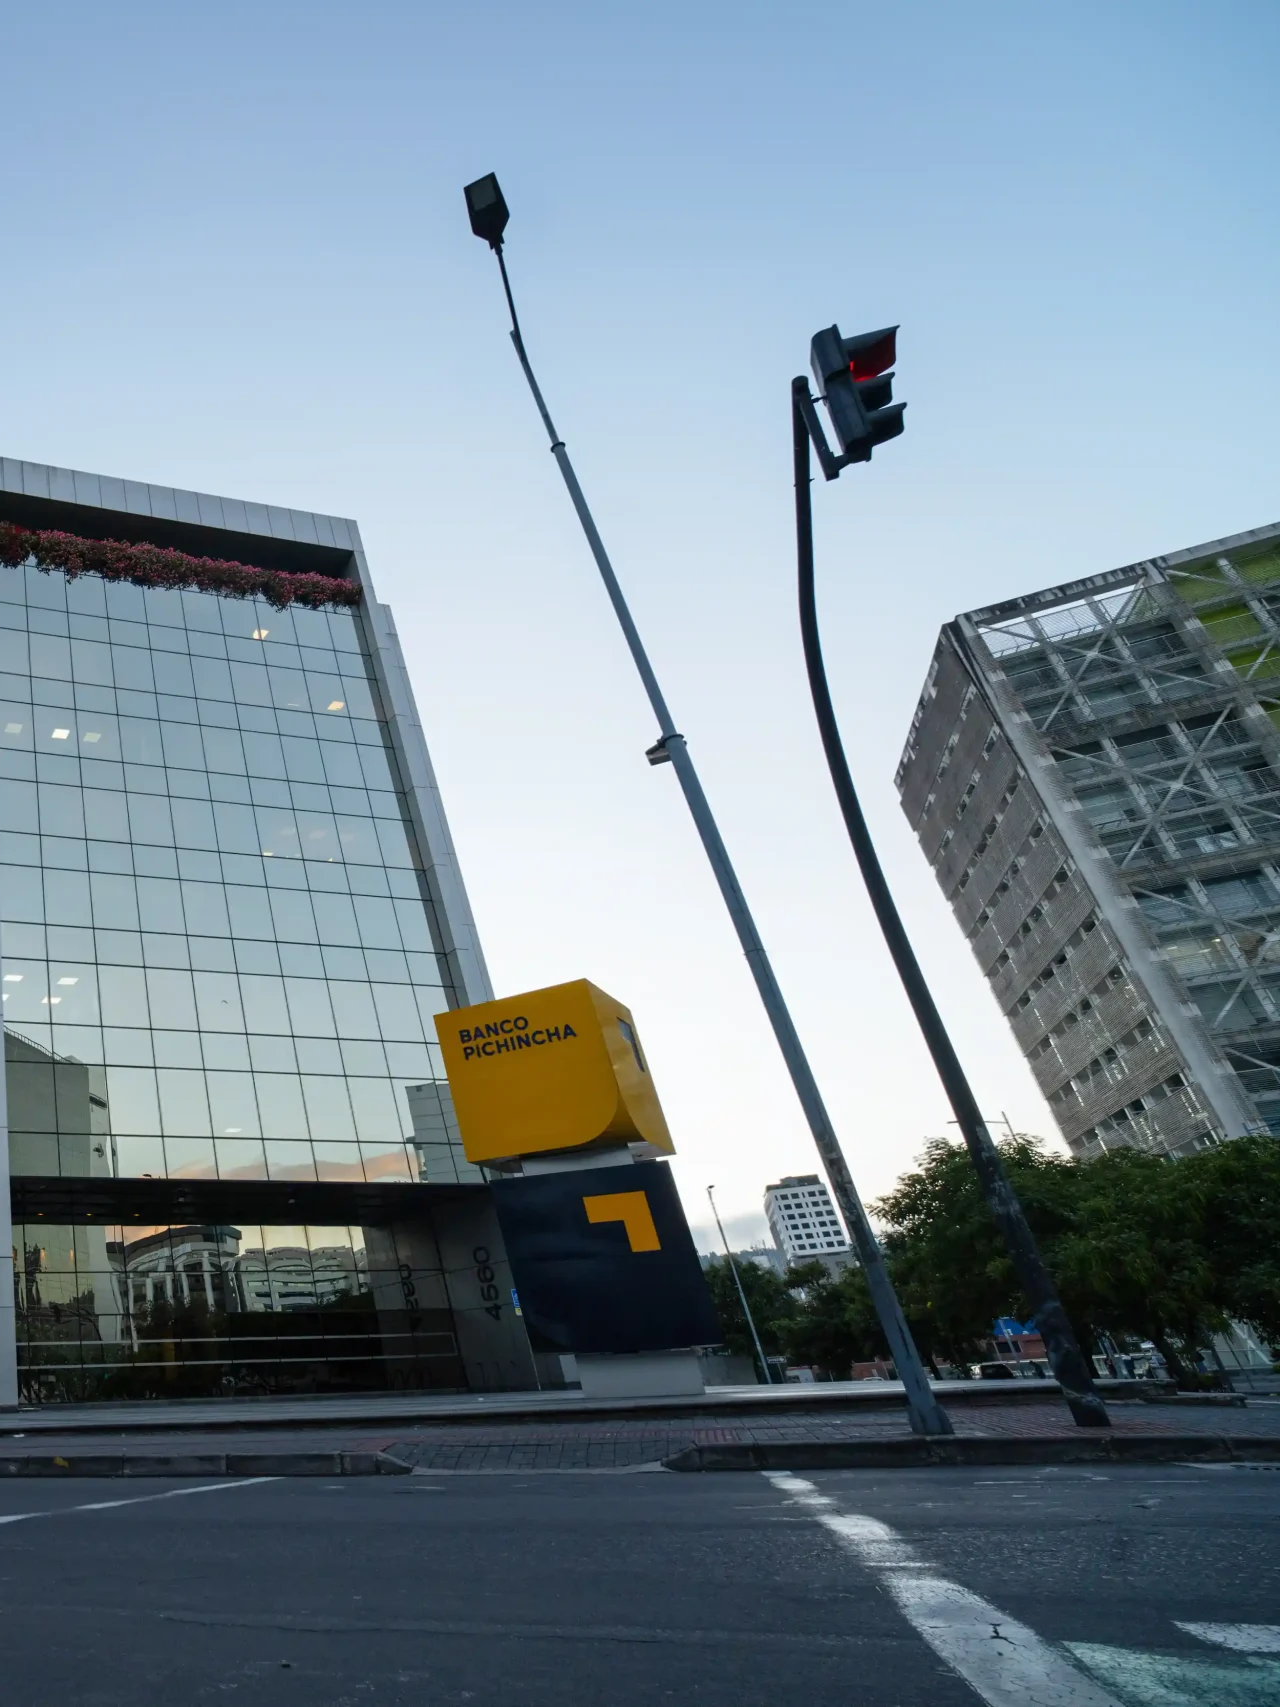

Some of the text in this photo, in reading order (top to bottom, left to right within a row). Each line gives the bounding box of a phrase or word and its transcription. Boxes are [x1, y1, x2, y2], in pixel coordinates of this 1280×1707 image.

[459, 1016, 528, 1044] BANCO
[463, 1024, 577, 1061] PICHINCHA
[472, 1246, 503, 1321] 4560
